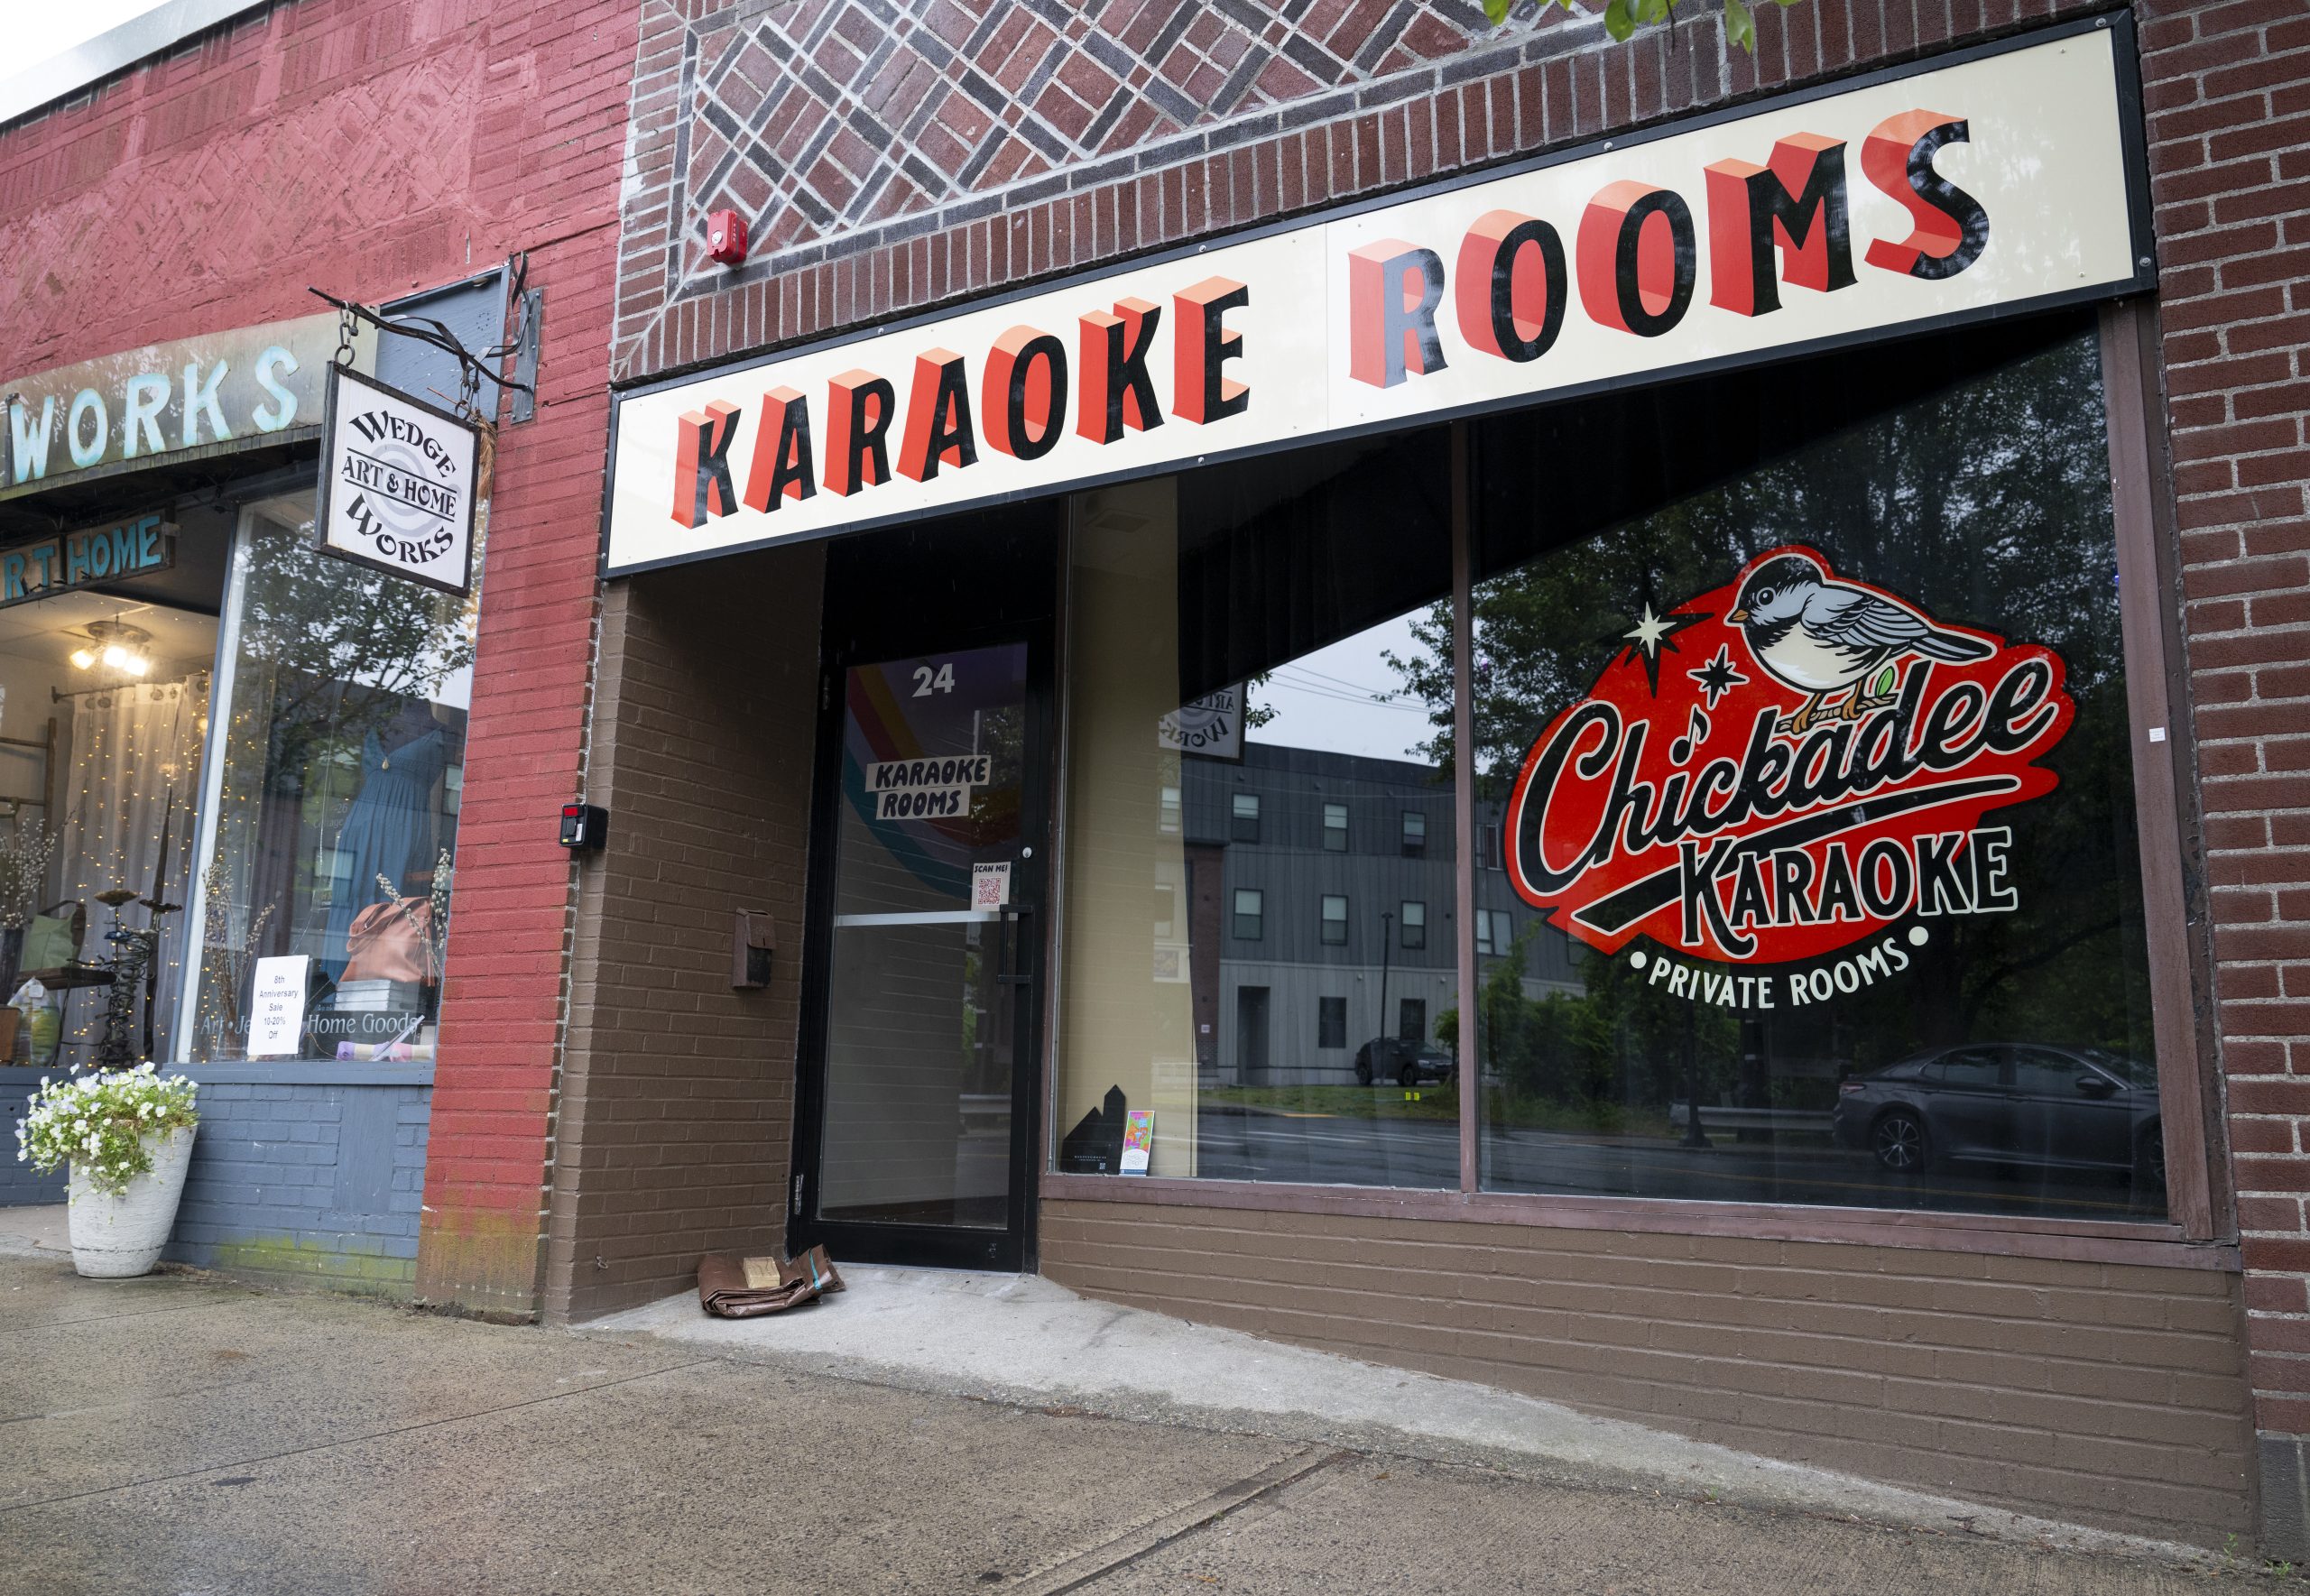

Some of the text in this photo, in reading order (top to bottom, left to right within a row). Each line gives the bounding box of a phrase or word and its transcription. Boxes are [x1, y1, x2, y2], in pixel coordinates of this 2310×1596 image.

[670, 108, 1991, 530] KARAOKE ROOMS
[10, 346, 300, 484] WORKS
[348, 410, 457, 478] WEDGE
[341, 456, 457, 518] ART & HOME
[346, 492, 454, 564] WORKS
[67, 514, 162, 586] HOME
[911, 663, 956, 697] 24
[875, 757, 988, 789] KARAOKE
[1517, 658, 2059, 897] Chickadee
[882, 789, 962, 818] ROOMS
[974, 863, 1009, 873] SCAN ME!
[1677, 825, 2019, 959] KARAOKE
[273, 975, 285, 984] 8th
[1648, 936, 1909, 1010] PRIVATE ROOMS
[259, 989, 299, 1000] Anniversary
[268, 1002, 283, 1011] Sale
[200, 1015, 225, 1035] Art
[307, 1013, 356, 1034] Home
[263, 1016, 286, 1026] 10-20%
[268, 1030, 279, 1039] Off
